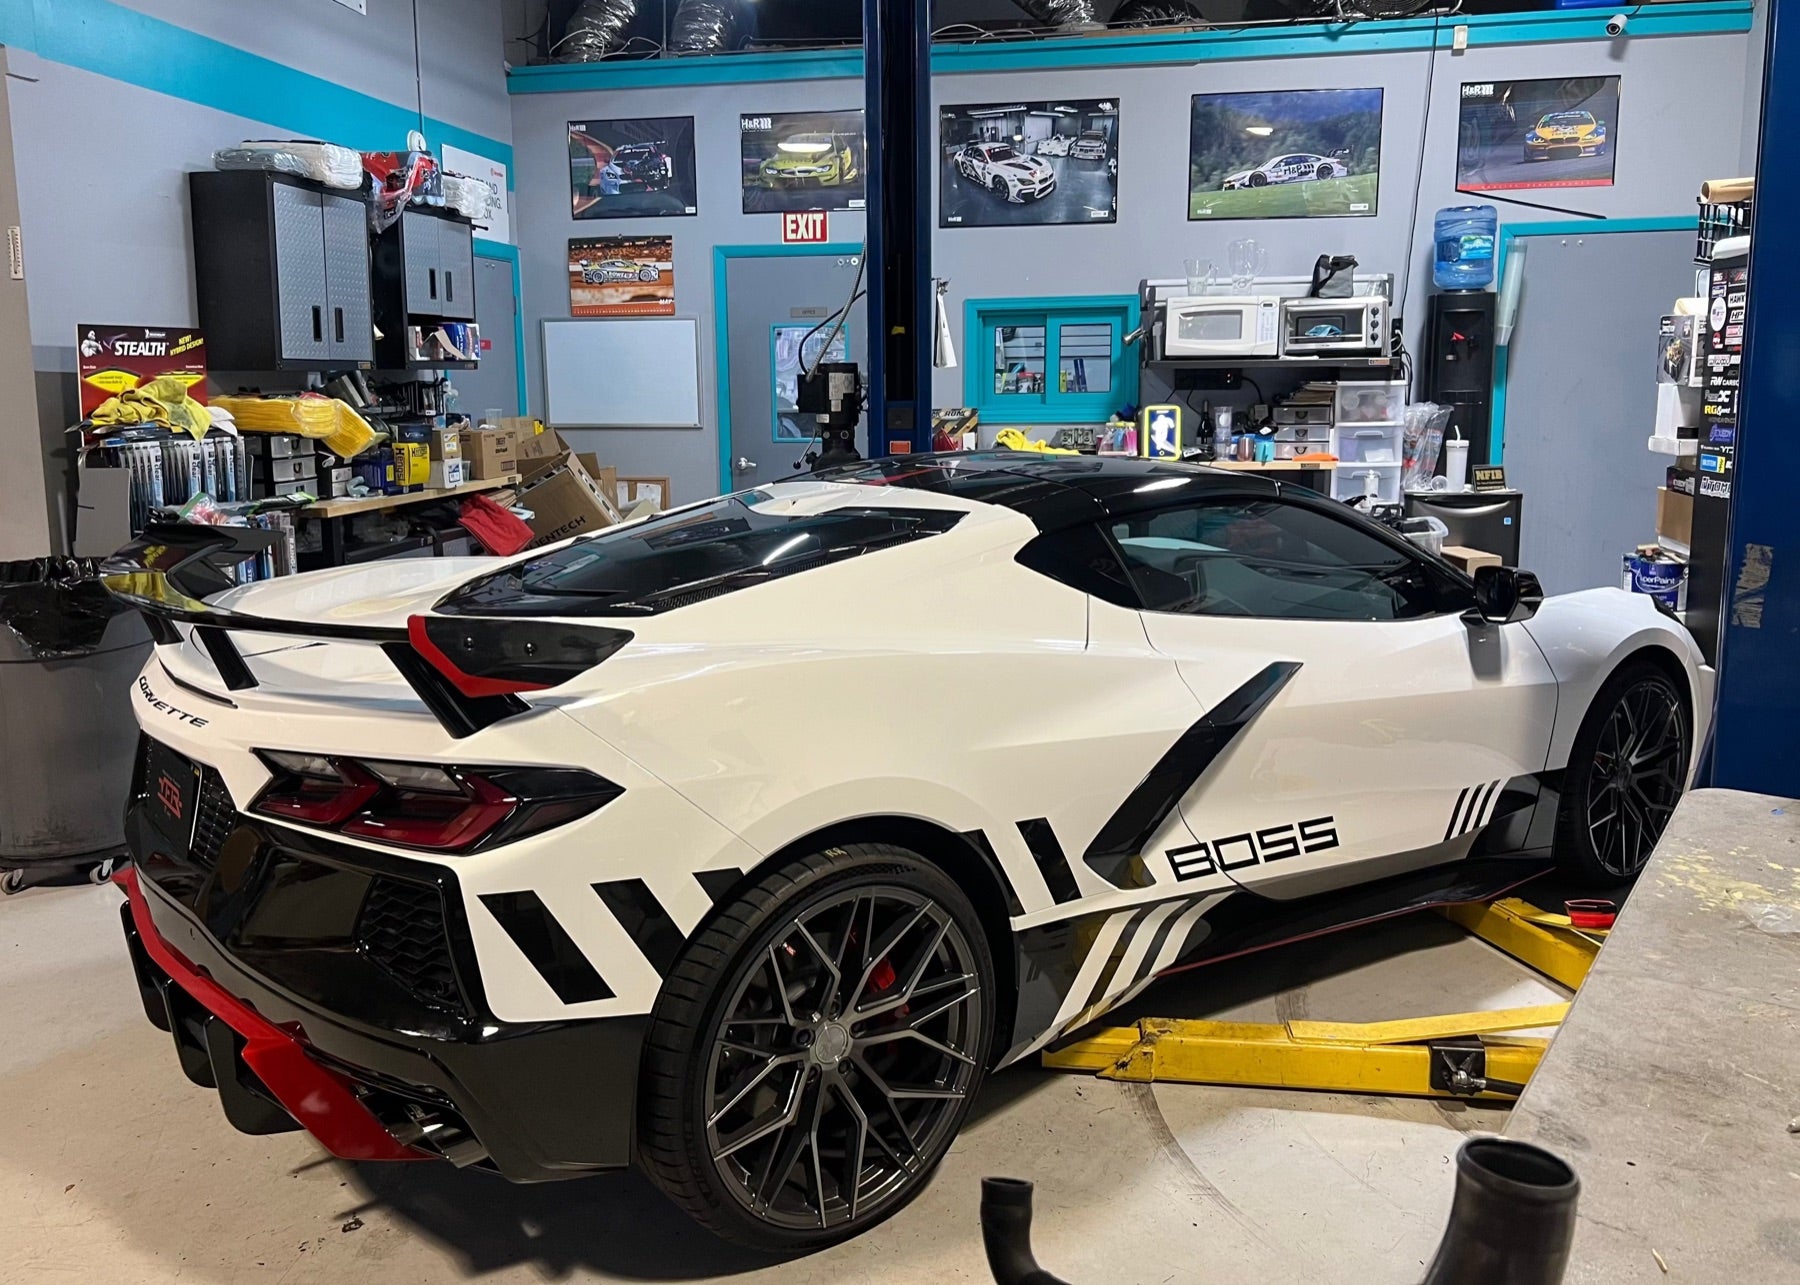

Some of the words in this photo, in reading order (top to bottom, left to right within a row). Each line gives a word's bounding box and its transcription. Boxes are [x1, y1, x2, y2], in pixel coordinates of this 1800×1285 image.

[786, 213, 824, 240] EXIT
[114, 341, 166, 356] STEALTH
[179, 334, 192, 346] NEW!
[1475, 470, 1503, 480] NFIB
[139, 676, 209, 728] CORVETTE
[1165, 815, 1339, 882] BOSS
